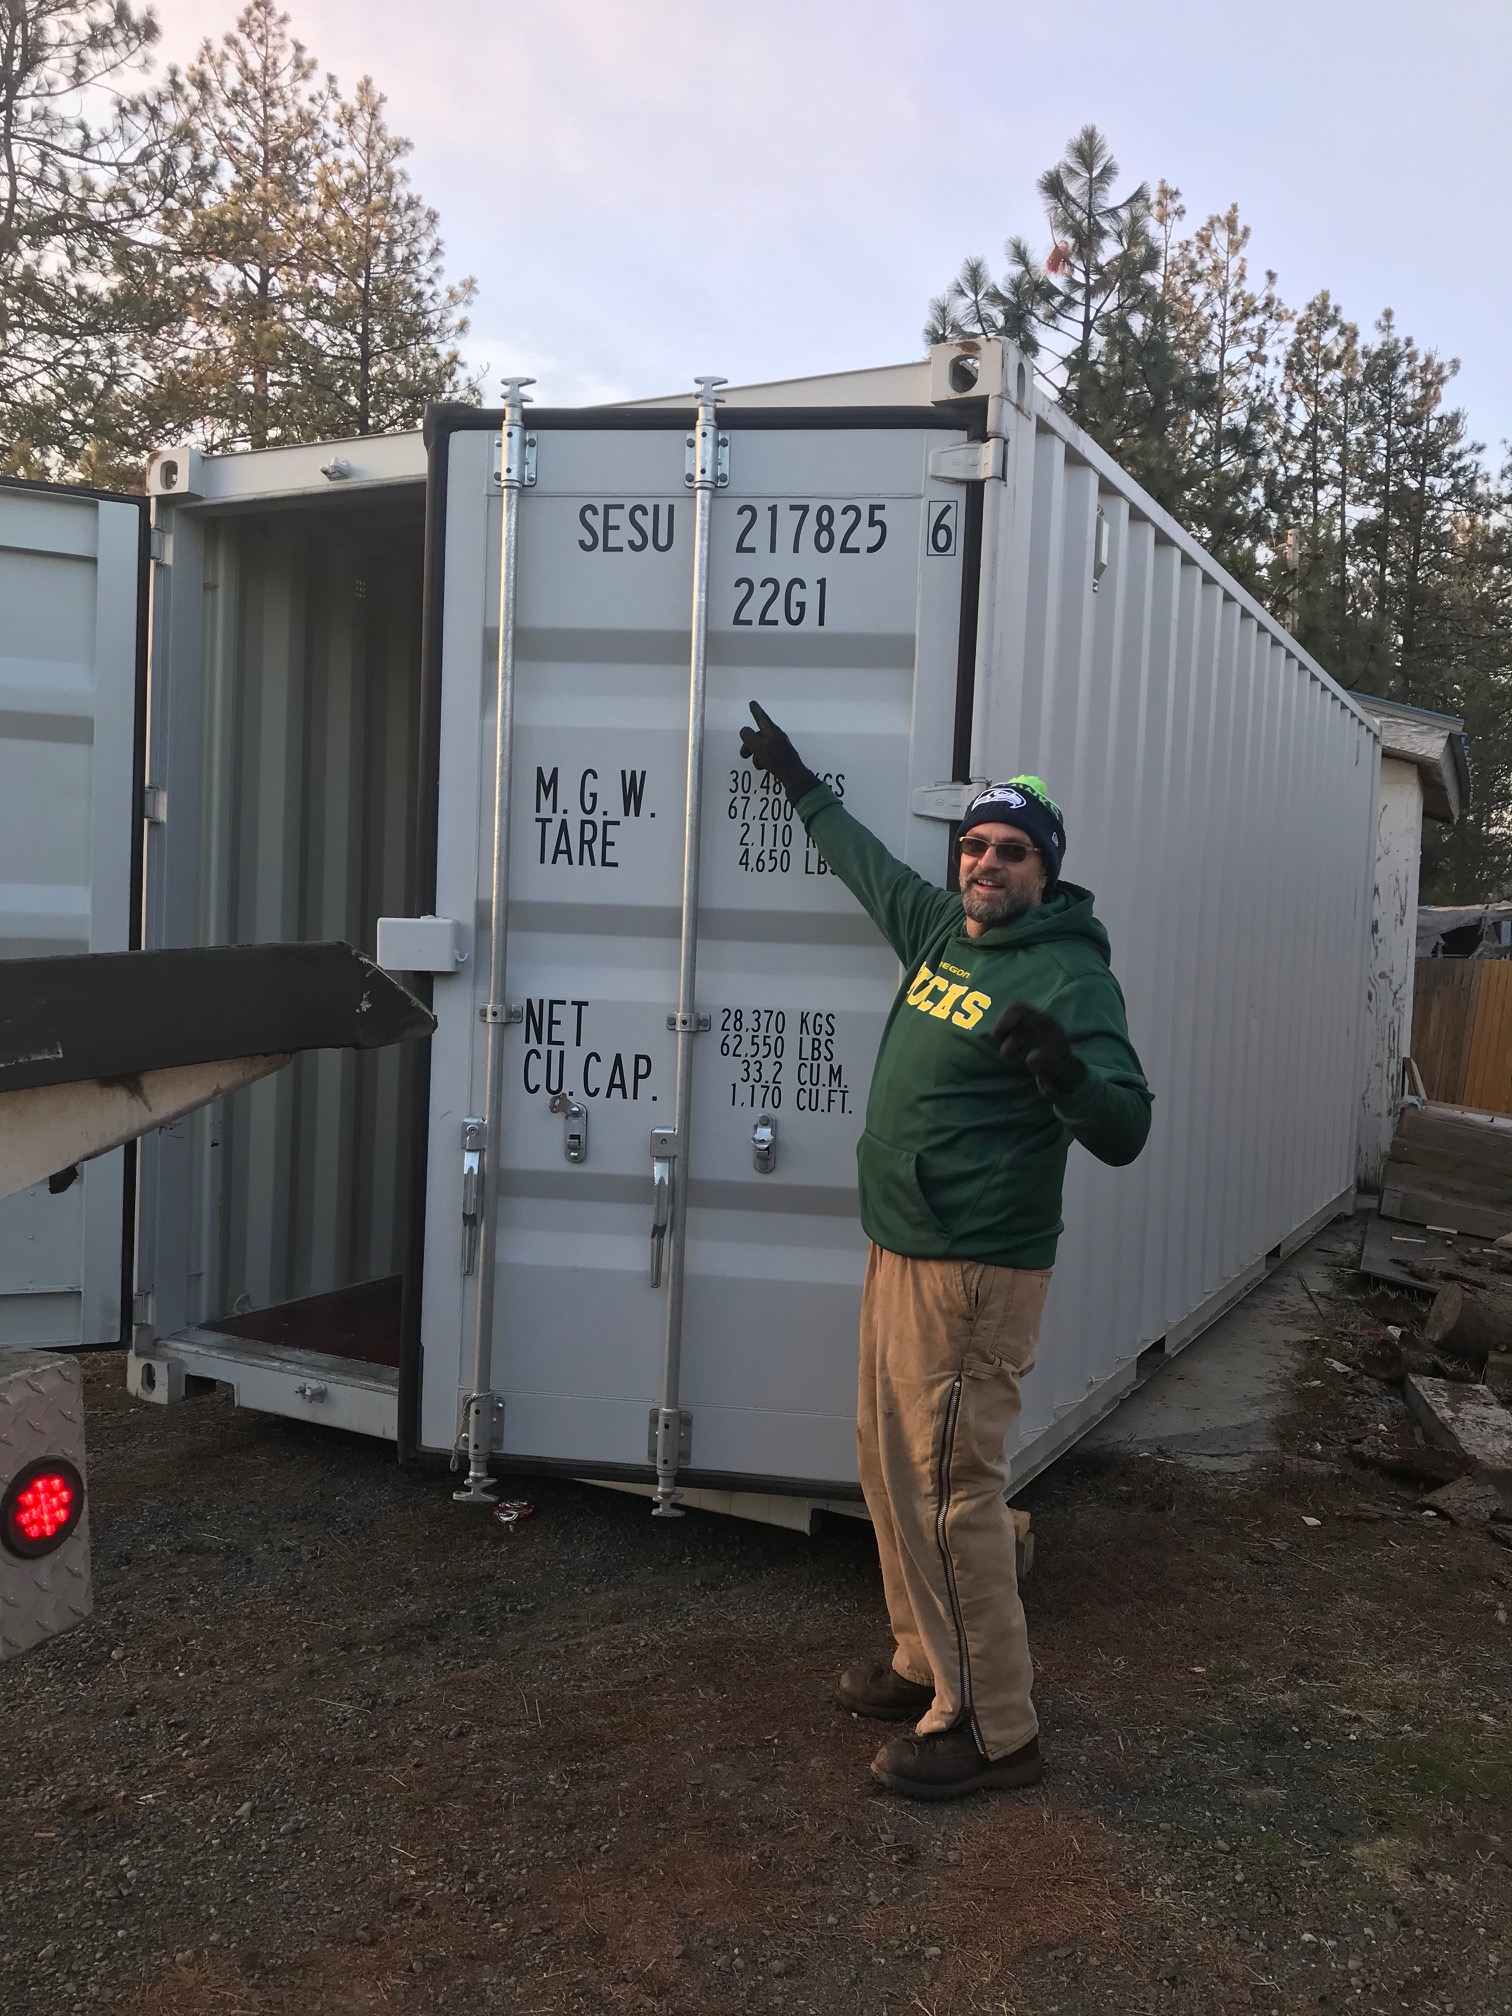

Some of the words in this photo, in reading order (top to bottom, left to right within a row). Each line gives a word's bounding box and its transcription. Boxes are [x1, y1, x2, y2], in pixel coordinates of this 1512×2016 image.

[578, 503, 675, 552] SESU
[735, 504, 888, 554] 217825
[931, 503, 953, 554] 6
[732, 577, 827, 627] 22G1
[729, 769, 784, 796] 30,48
[727, 796, 794, 821] 67,200
[534, 817, 621, 868] TARE
[739, 822, 793, 848] 2,110
[738, 848, 791, 873] 4,650
[804, 850, 838, 876] LB
[906, 961, 992, 1031] UCKS
[524, 998, 589, 1047] NET
[720, 1008, 786, 1035] 28,370
[799, 1011, 836, 1036] KGS
[720, 1033, 785, 1059] 62,550
[798, 1036, 834, 1062] LBS
[740, 1059, 783, 1084] 33.2
[797, 1062, 848, 1088] CU.M.
[731, 1082, 782, 1109] 1,170
[796, 1087, 853, 1114] CU.FT.
